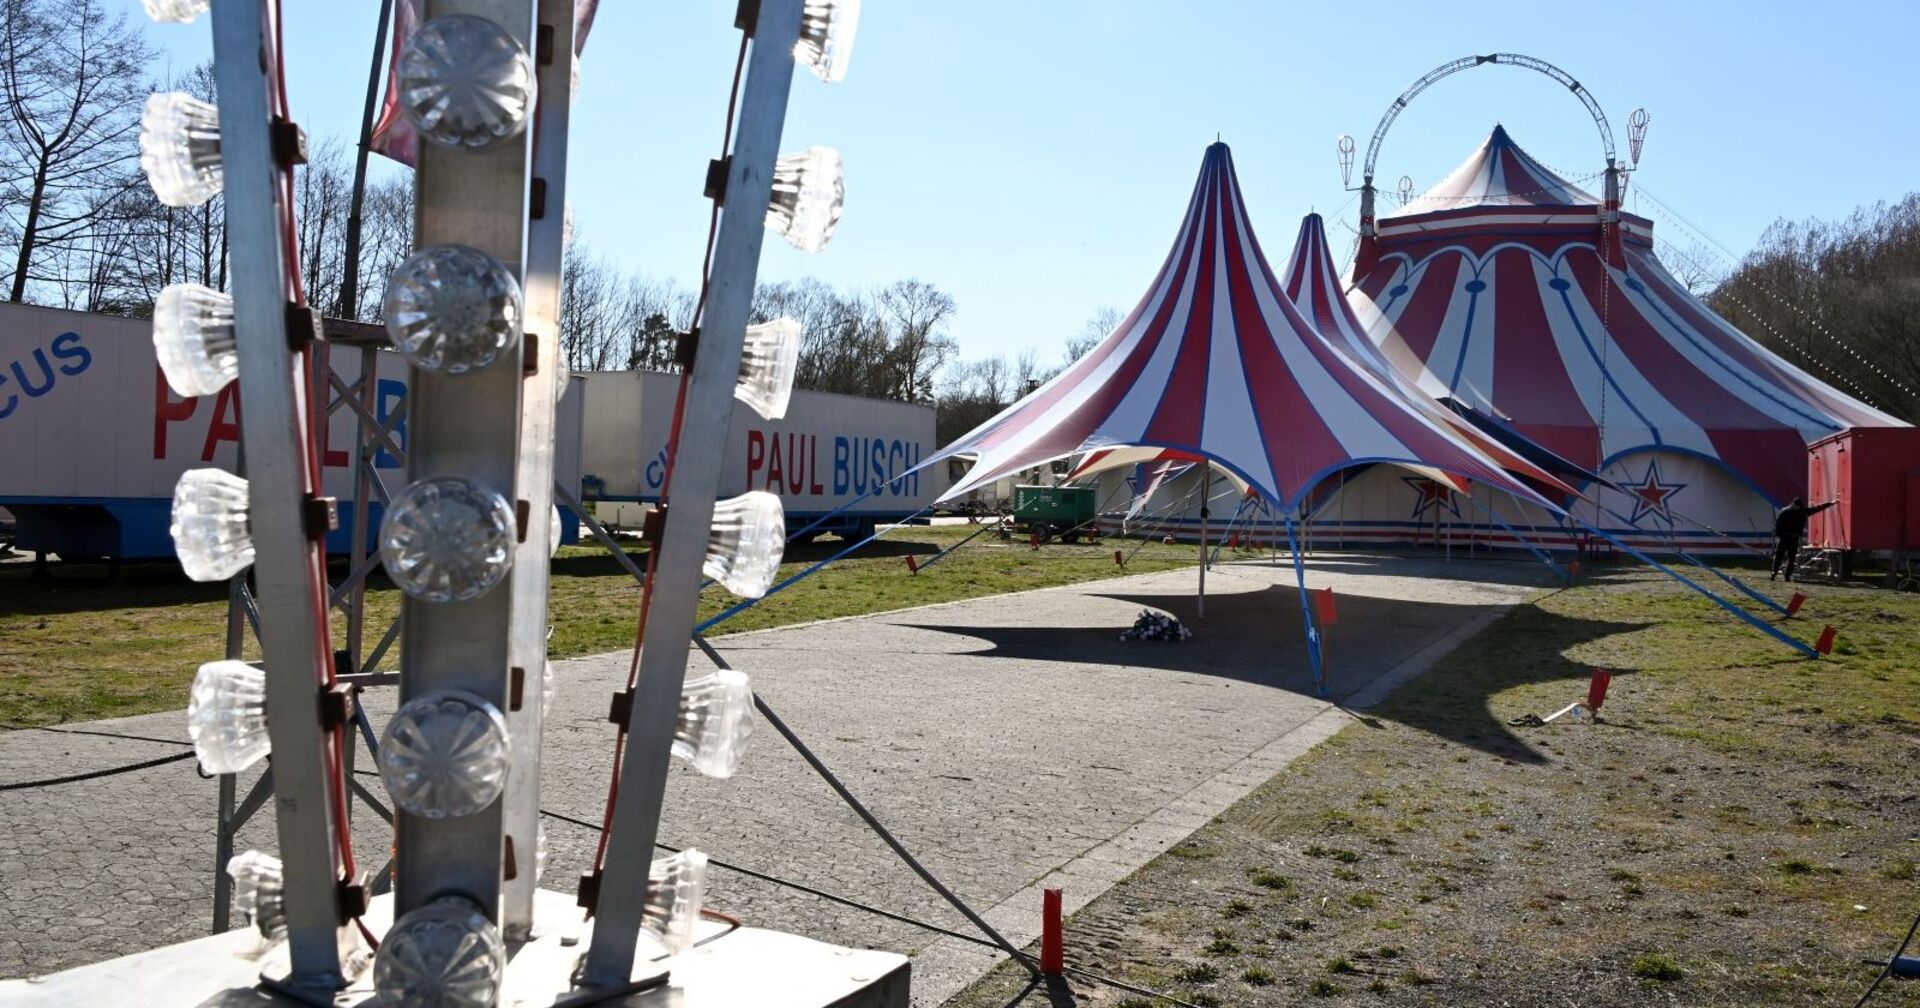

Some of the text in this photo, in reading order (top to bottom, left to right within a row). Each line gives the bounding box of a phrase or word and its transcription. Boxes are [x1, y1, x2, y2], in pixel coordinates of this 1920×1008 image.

[153, 359, 349, 467] PAL
[746, 430, 824, 496] PAUL
[833, 436, 920, 497] BUSCH
